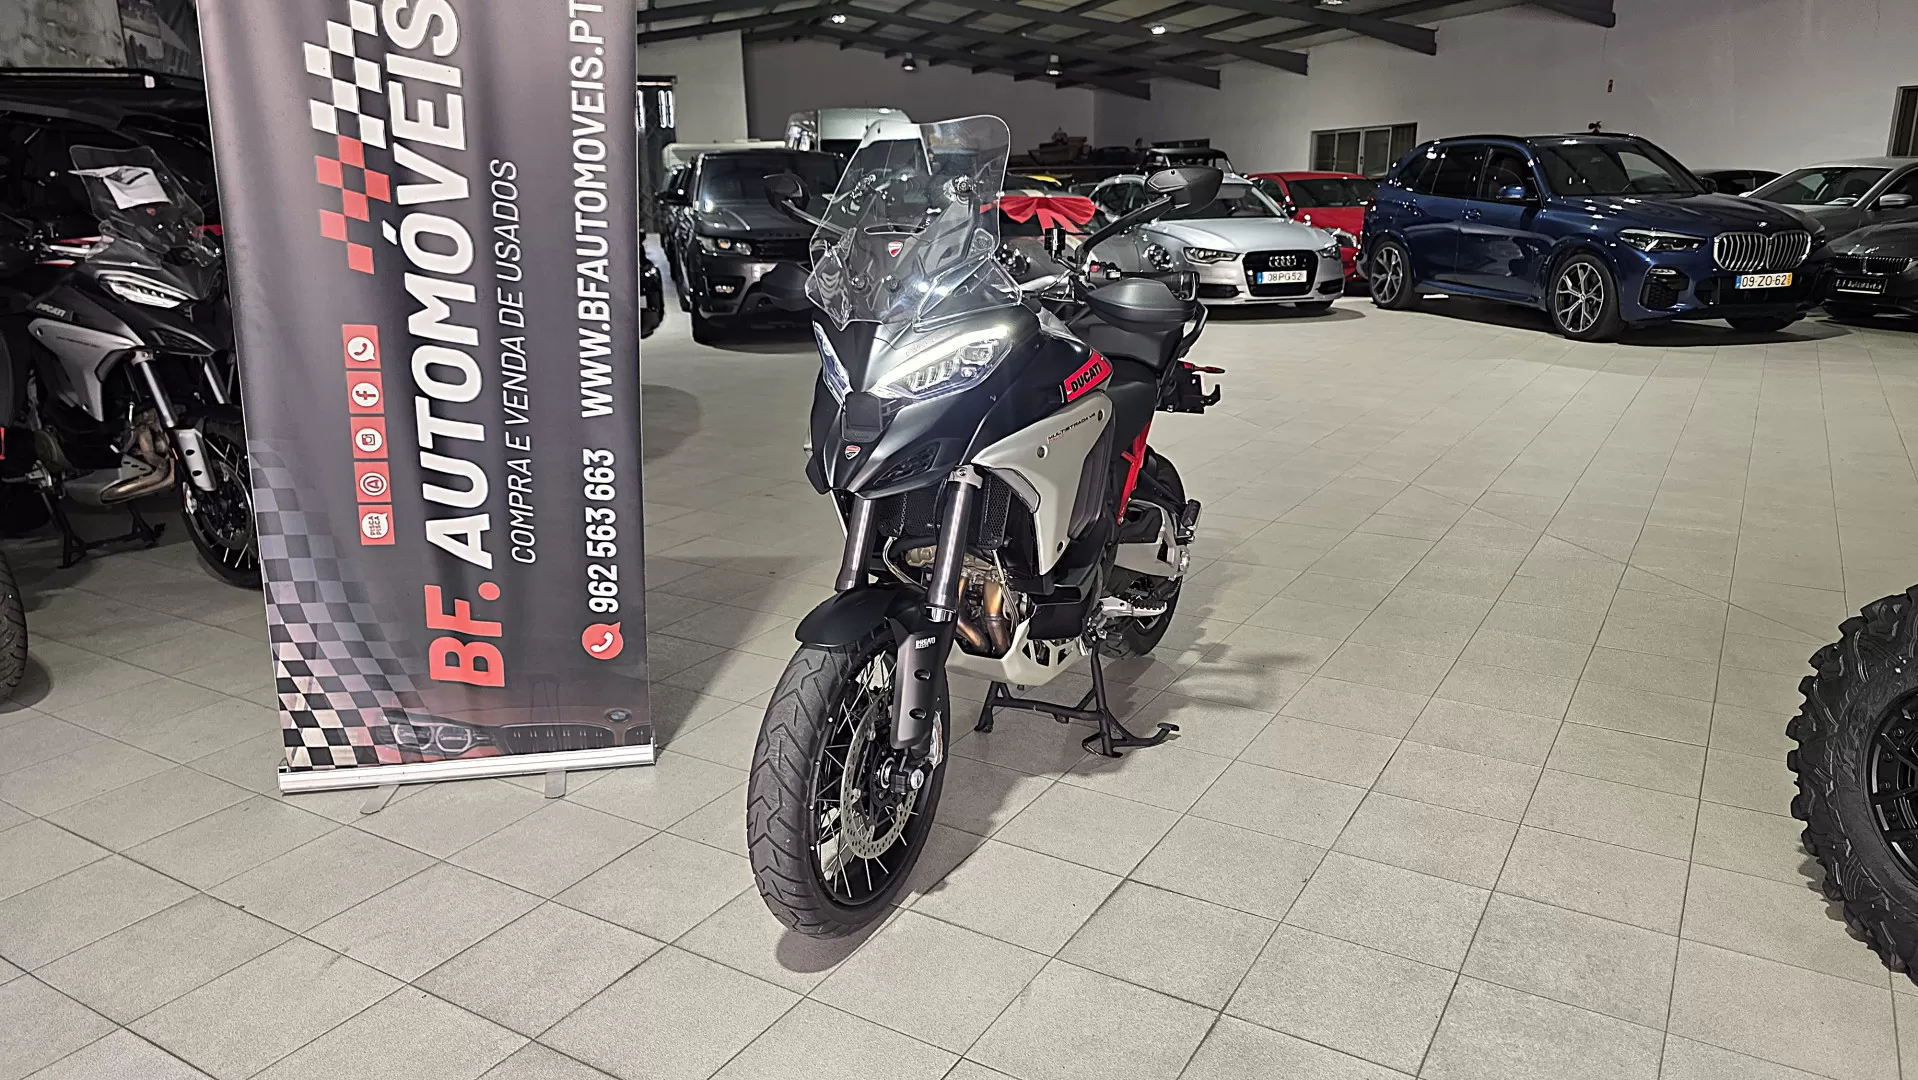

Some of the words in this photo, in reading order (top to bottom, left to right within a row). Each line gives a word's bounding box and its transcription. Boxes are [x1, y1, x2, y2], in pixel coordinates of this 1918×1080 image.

[490, 159, 522, 282] USADOS
[569, 0, 614, 418] WWW.BFAUTOMOVEIS.PT
[1741, 274, 1787, 288] 09-ZO-62
[497, 287, 525, 328] DE
[500, 336, 530, 425] VENDA
[1071, 362, 1102, 392] DUCATI
[505, 431, 531, 451] E
[582, 449, 616, 501] 663
[507, 458, 537, 564] COMPRA
[585, 507, 618, 559] 563
[586, 564, 619, 613] 962
